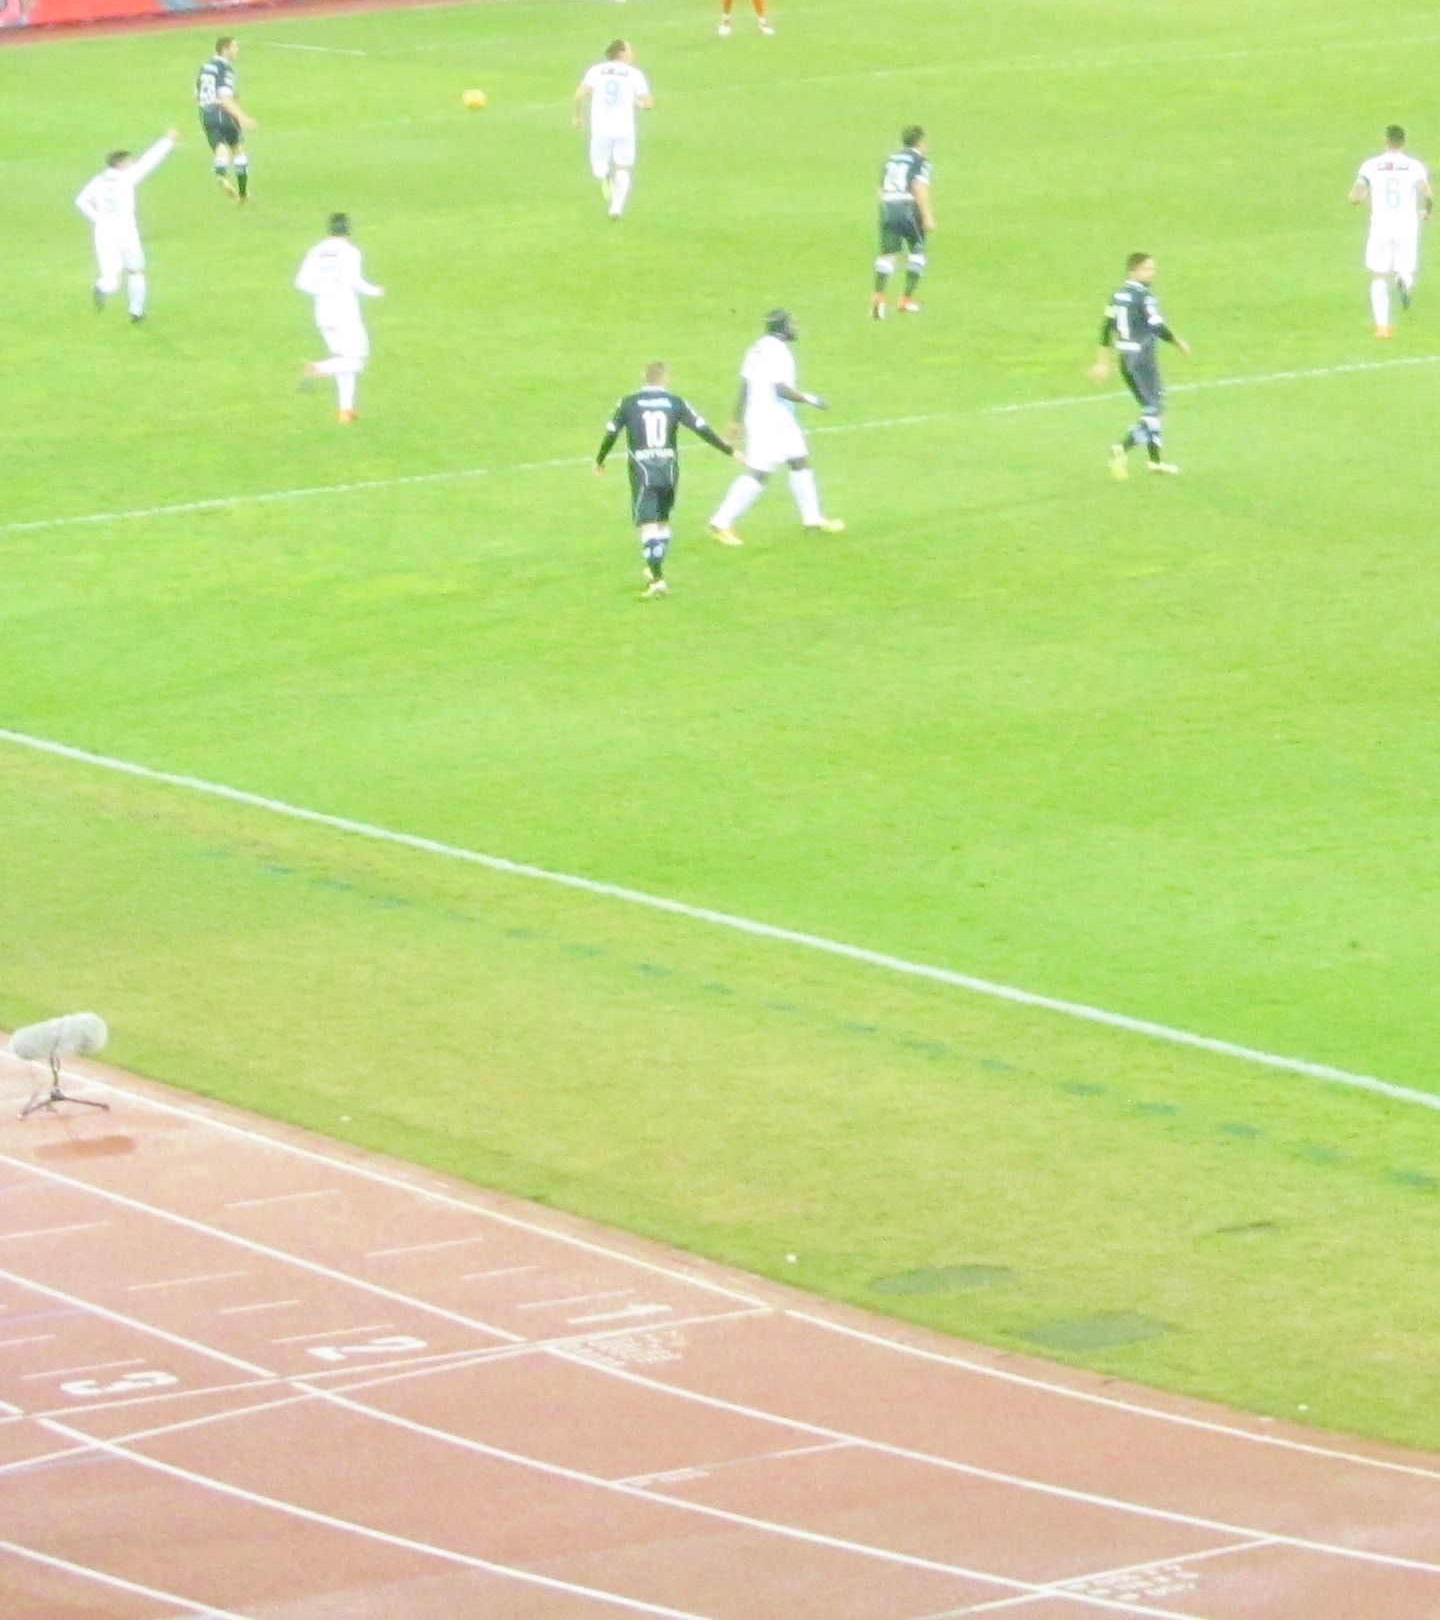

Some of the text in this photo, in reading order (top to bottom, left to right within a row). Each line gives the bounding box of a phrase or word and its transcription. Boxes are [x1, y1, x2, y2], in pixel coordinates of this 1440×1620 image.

[604, 79, 621, 107] 9
[1385, 177, 1402, 209] 6
[642, 409, 668, 449] 10
[306, 1333, 429, 1362] 2
[57, 1369, 181, 1398] 3
